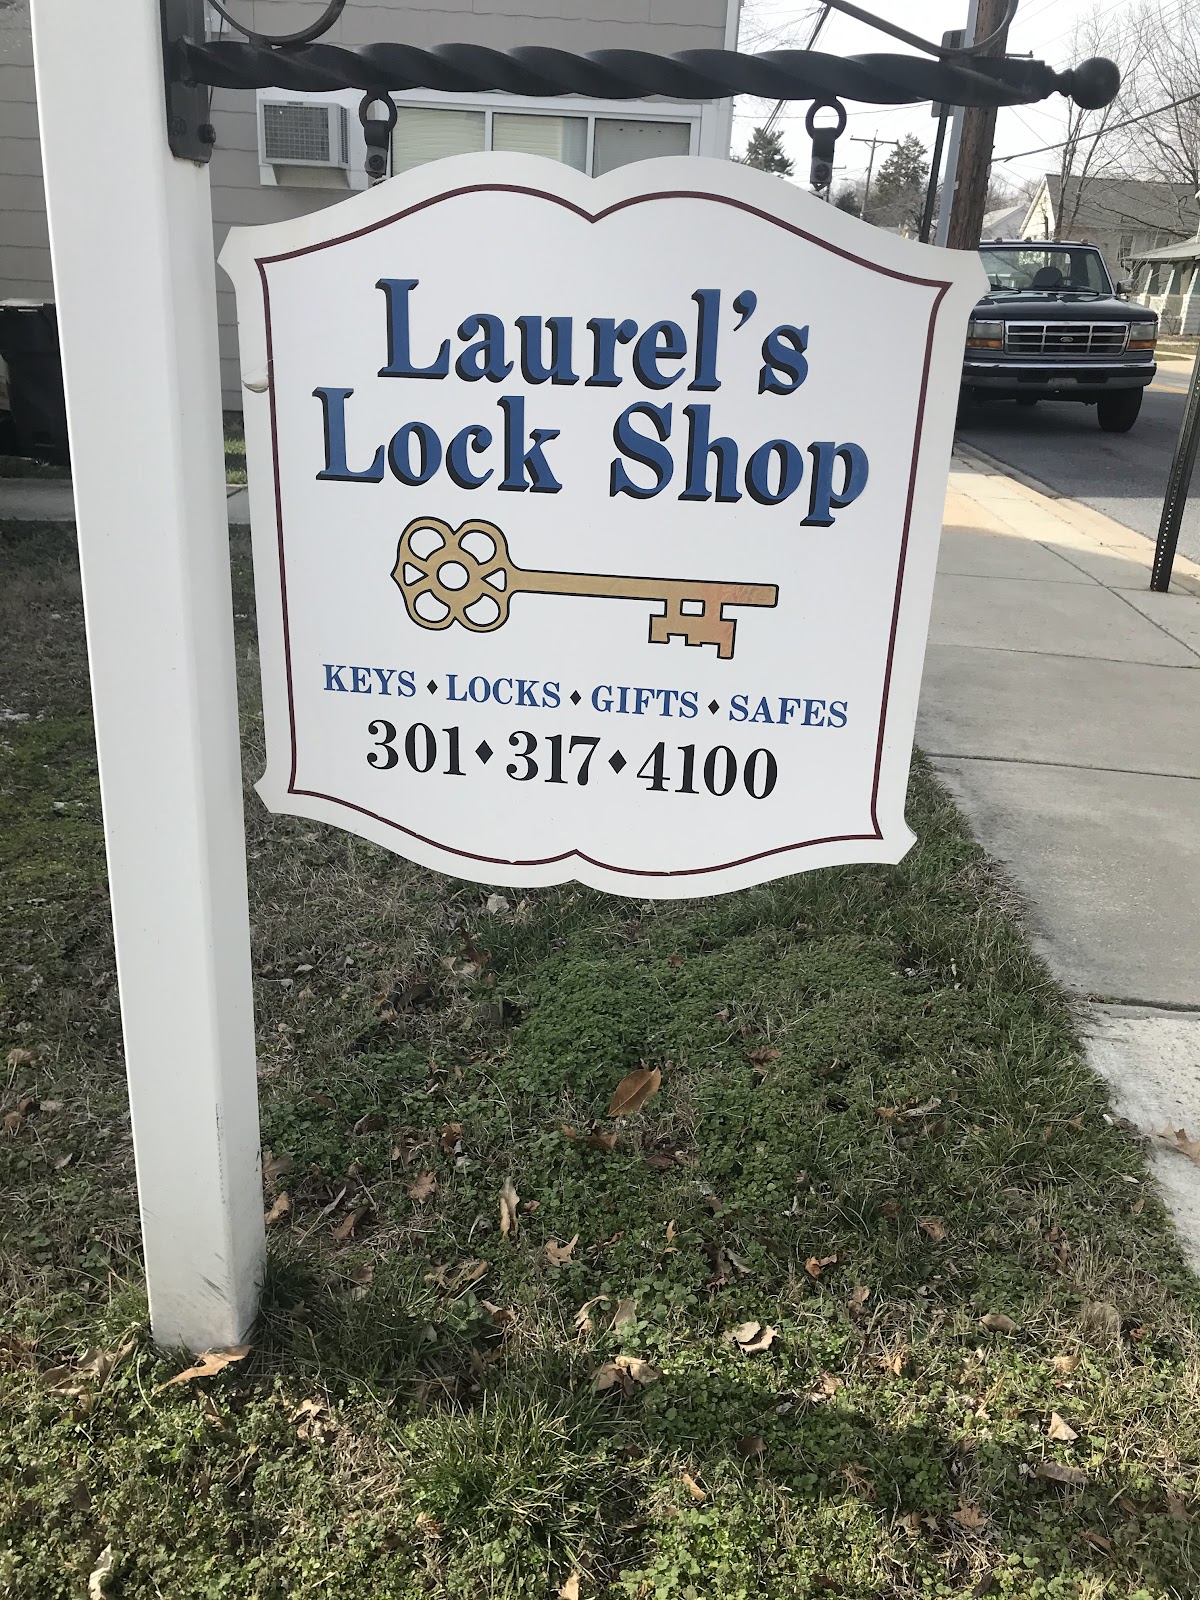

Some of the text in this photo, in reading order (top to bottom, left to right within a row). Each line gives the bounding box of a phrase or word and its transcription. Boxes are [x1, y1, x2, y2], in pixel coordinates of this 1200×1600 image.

[374, 278, 810, 396] Laurel's
[312, 386, 869, 528] Lock Shop
[322, 663, 848, 729] KEYS LOCKS GIFTS SAFES
[366, 719, 778, 800] 301 317 4100
